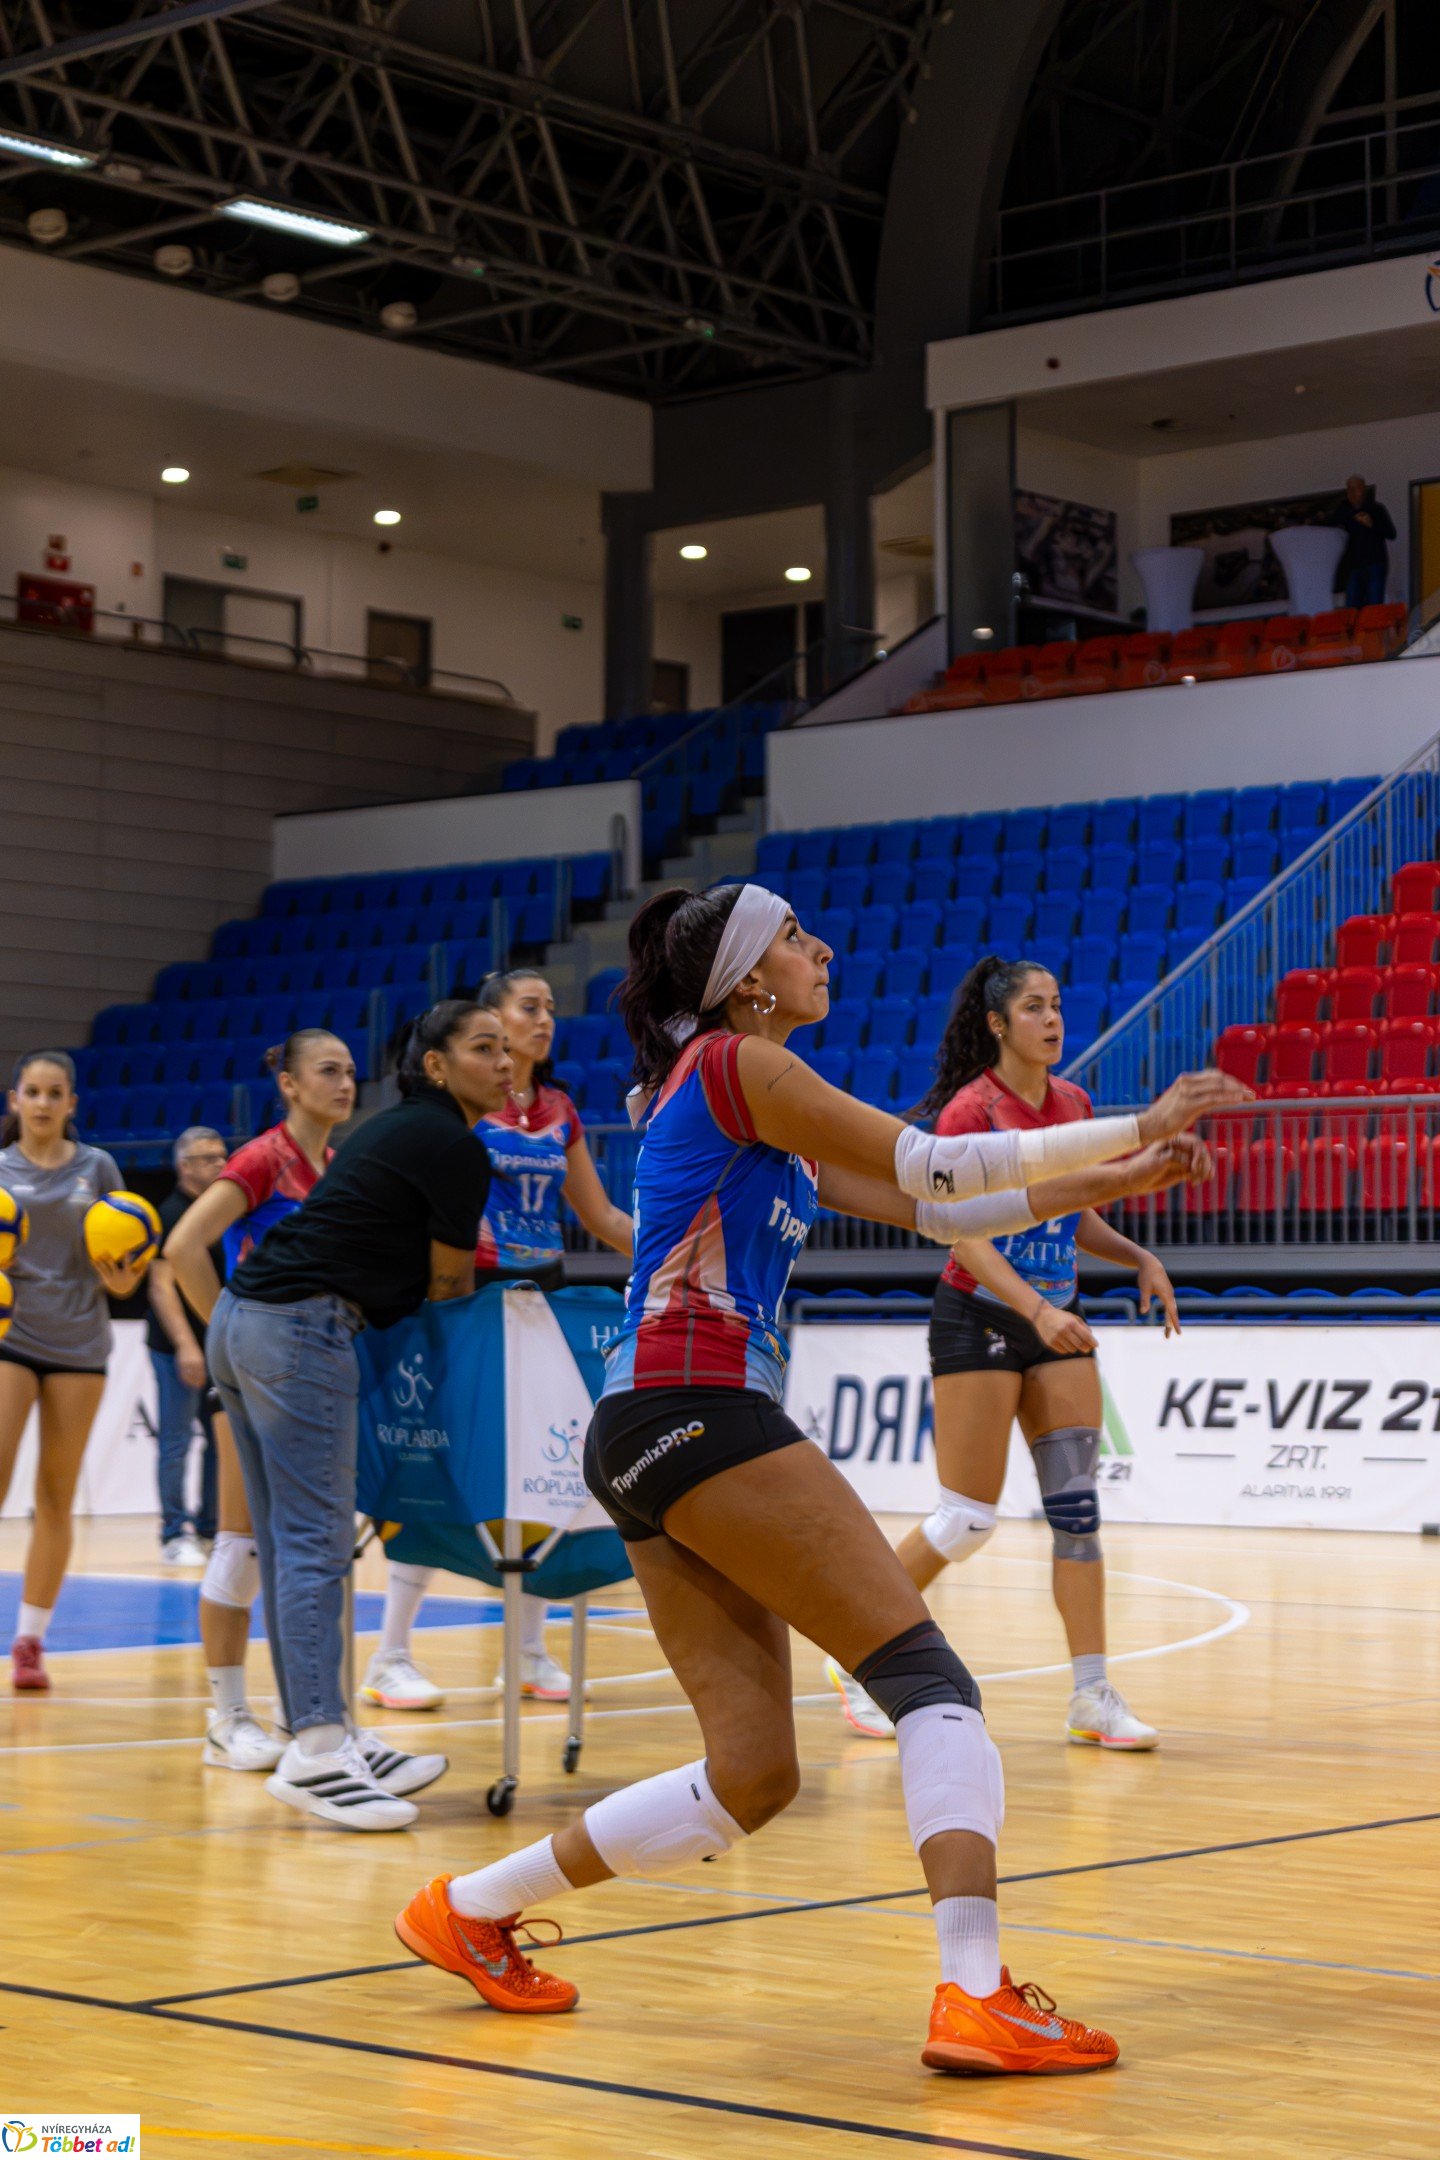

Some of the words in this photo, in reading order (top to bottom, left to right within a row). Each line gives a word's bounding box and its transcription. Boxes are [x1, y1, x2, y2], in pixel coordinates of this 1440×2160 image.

[519, 1173, 553, 1213] 17
[1158, 1378, 1372, 1430] KE-VIZ
[611, 1420, 705, 1495] TippmixPRO
[1266, 1445, 1328, 1470] ZRT.
